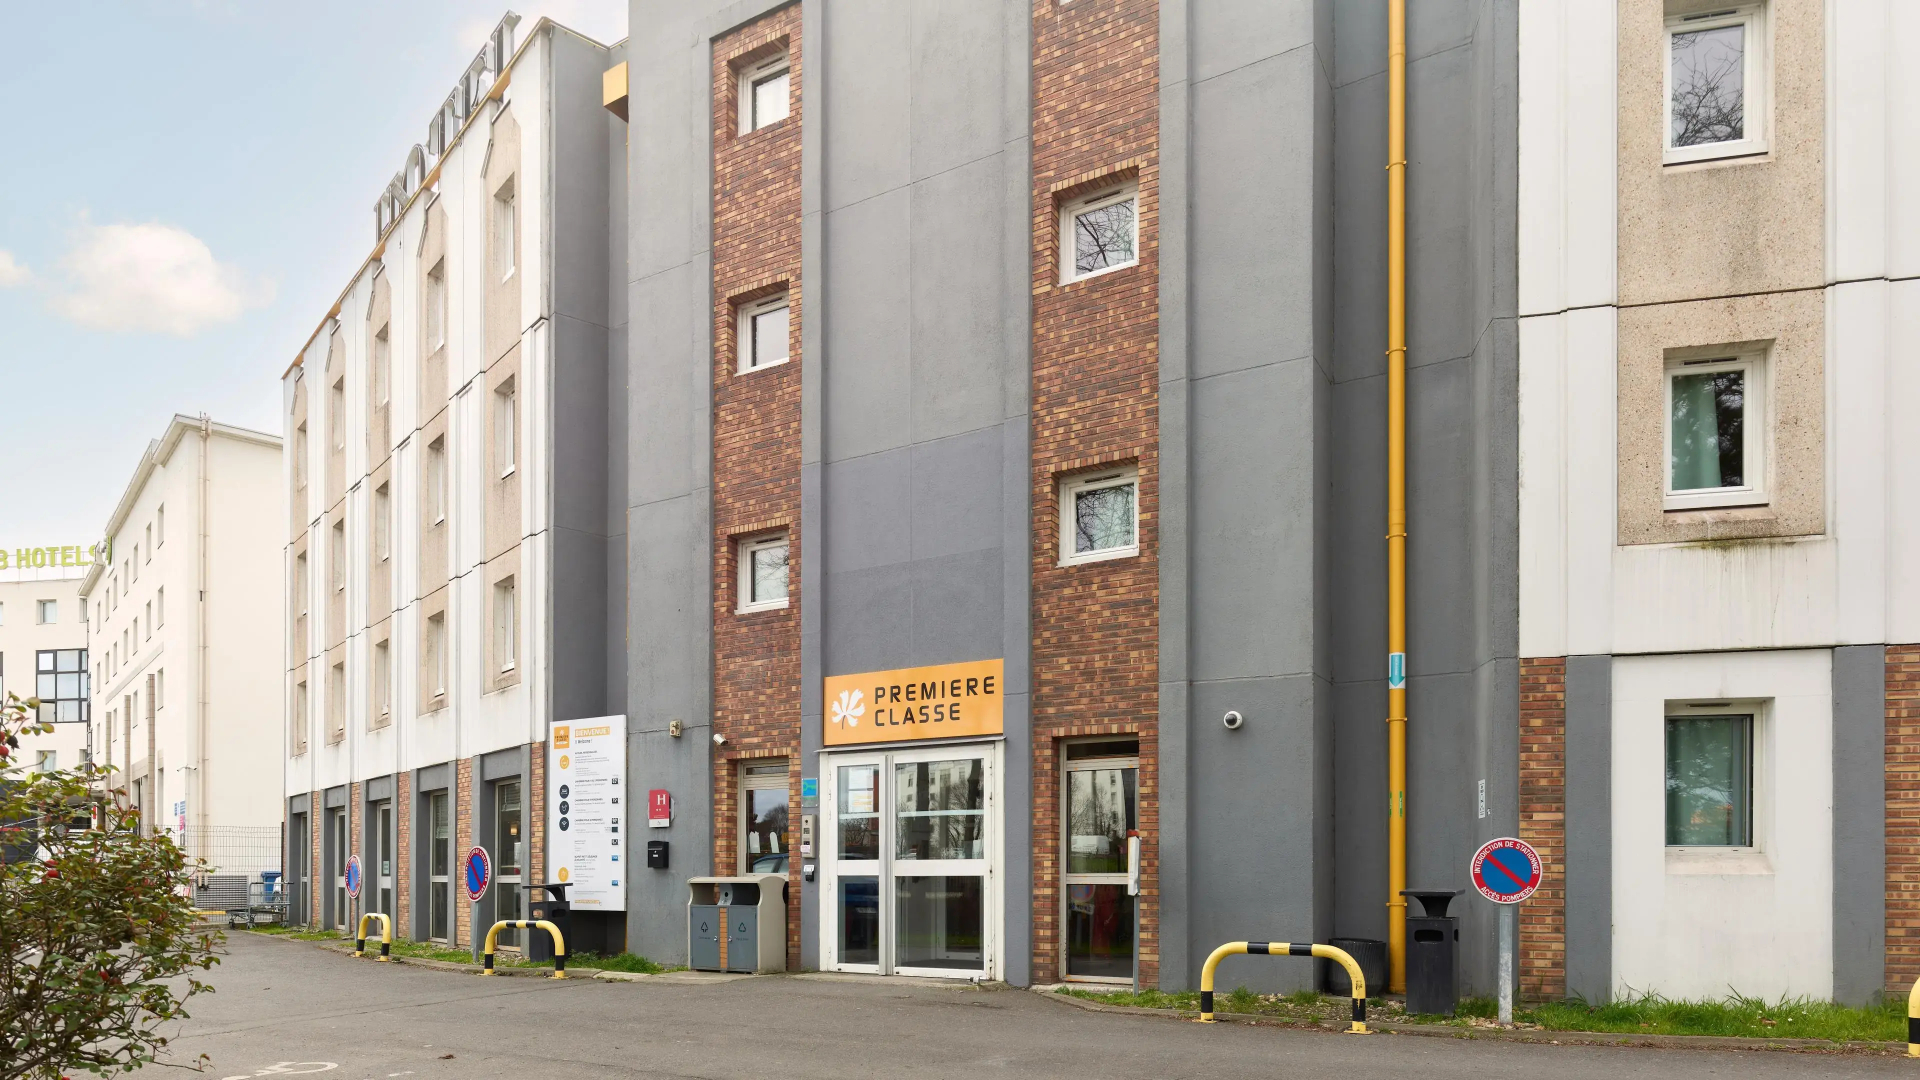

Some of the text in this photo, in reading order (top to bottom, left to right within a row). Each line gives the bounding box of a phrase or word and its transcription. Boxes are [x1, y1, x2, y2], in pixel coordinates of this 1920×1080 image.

[875, 676, 995, 704] PREMIERE
[875, 703, 960, 727] CLASSE
[657, 794, 666, 806] H
[1474, 842, 1503, 874] INTERDICTION
[1516, 843, 1539, 875] STATIONNER
[1502, 886, 1533, 902] POMPIERS
